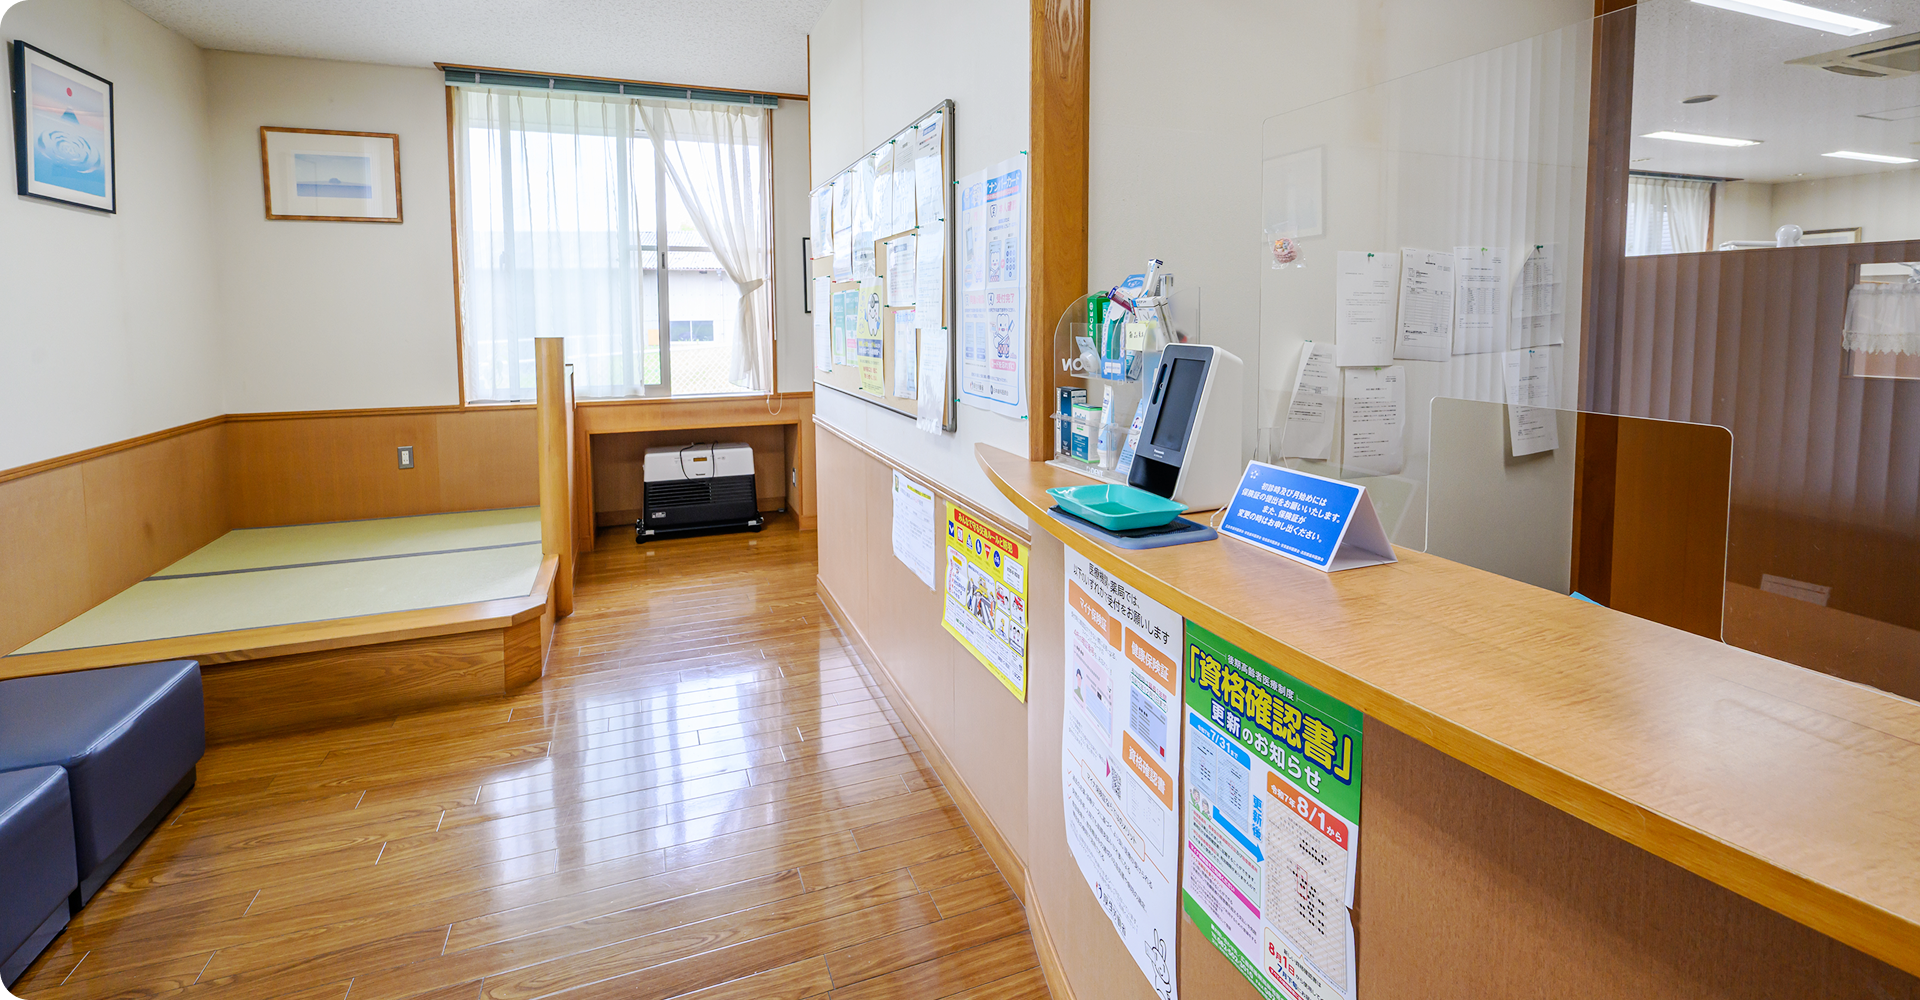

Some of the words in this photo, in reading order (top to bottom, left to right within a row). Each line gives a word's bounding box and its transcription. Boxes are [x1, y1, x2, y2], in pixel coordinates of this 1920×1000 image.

[1241, 488, 1340, 524] 保険証の提出をお願いいたします。
[1261, 482, 1327, 507] 初診時及び月始めには
[1262, 505, 1307, 525] また、保険証が
[1237, 508, 1322, 543] 変更の時はお申し出ください。
[1079, 597, 1107, 632] マイナ保険証
[1131, 641, 1169, 682] 健康保険証
[1228, 654, 1295, 702] 後期高齢者医療制度
[1190, 644, 1354, 785] 「資格確認書」
[1211, 700, 1322, 794] 更新のお知らせ
[1128, 745, 1166, 796] 資格確認書
[1252, 794, 1263, 842] 更新後
[1271, 784, 1342, 843] 令和7年8/1から
